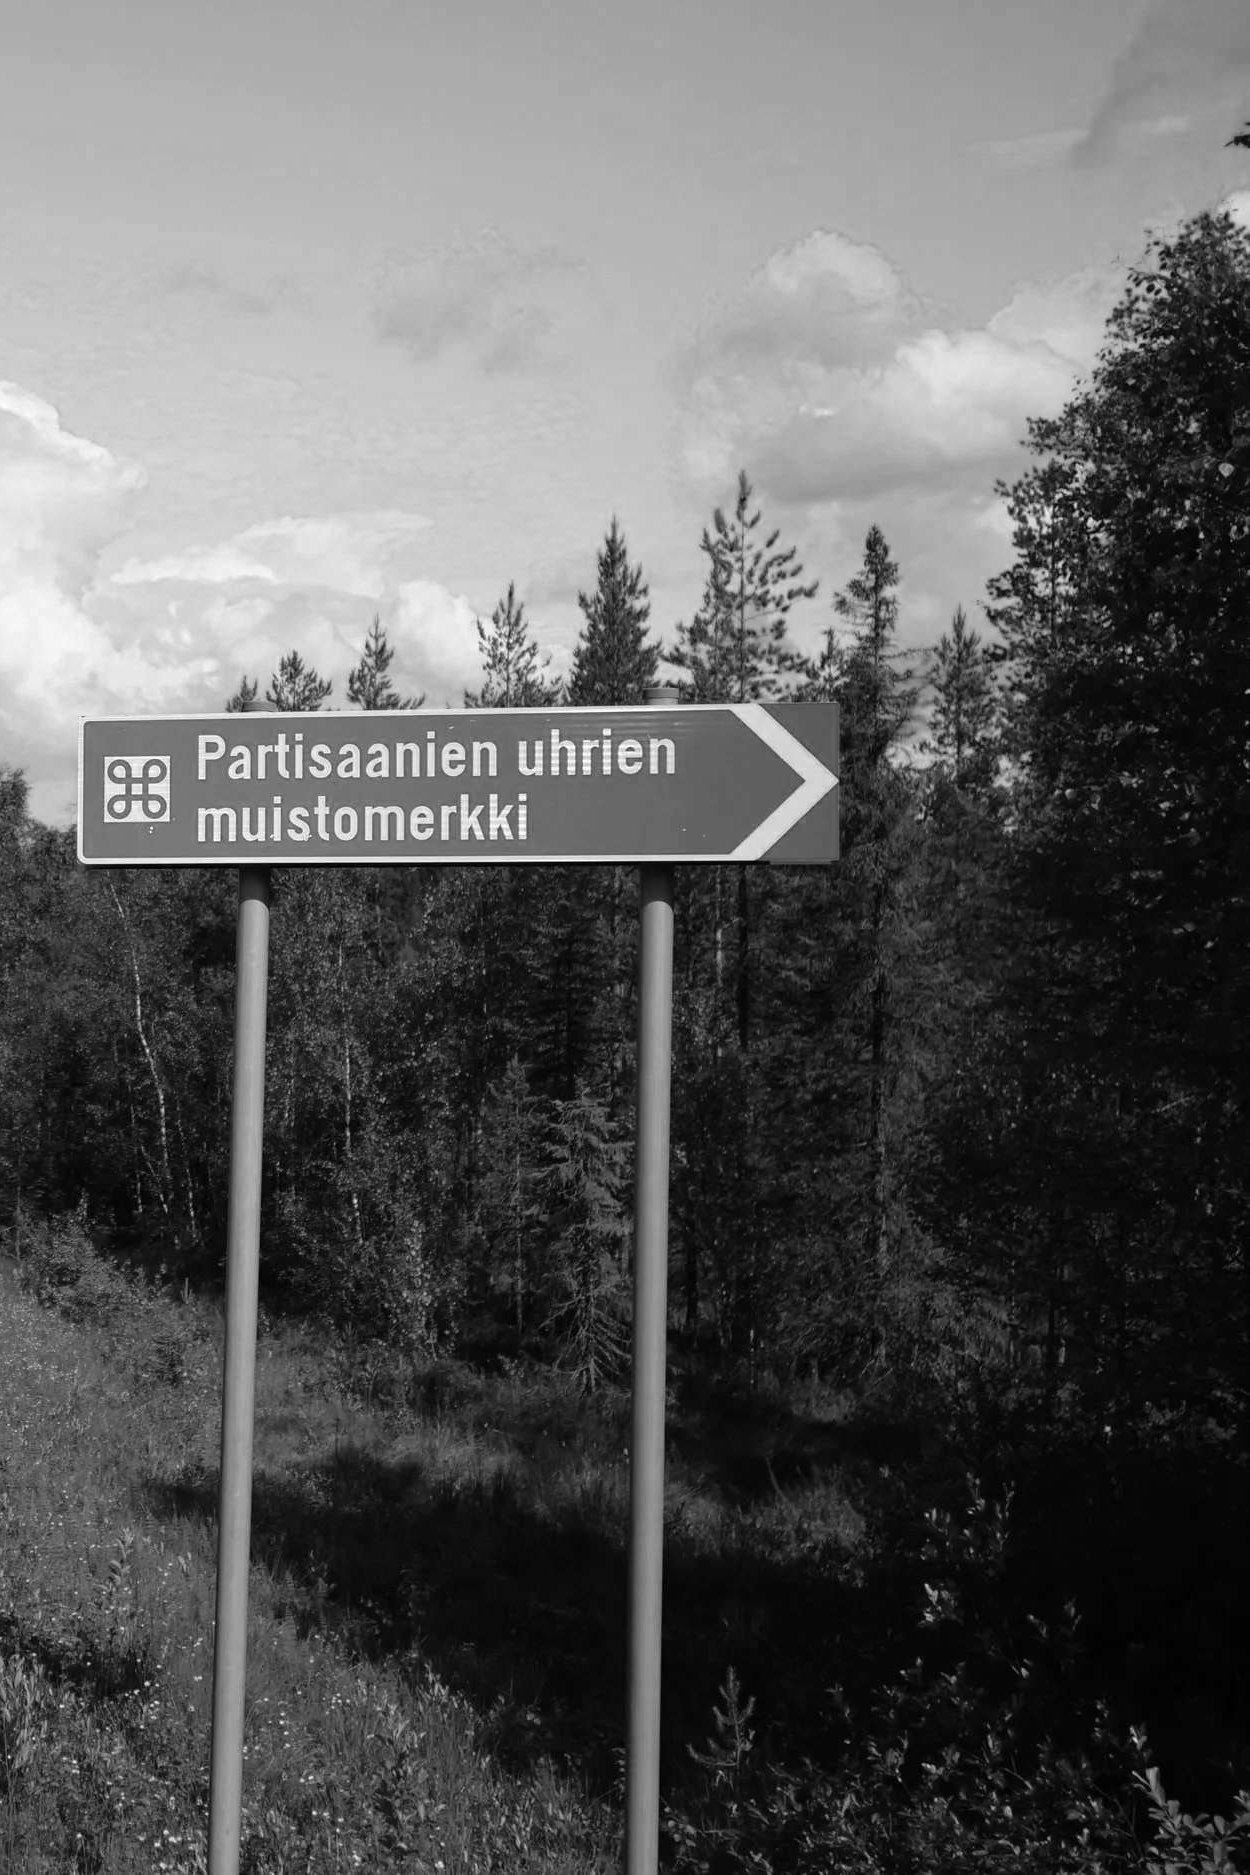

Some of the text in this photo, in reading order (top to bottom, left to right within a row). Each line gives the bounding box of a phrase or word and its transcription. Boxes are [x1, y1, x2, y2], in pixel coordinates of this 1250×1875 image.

[197, 728, 675, 780] Partisaanien uhrien
[197, 793, 528, 842] muistomerkki
